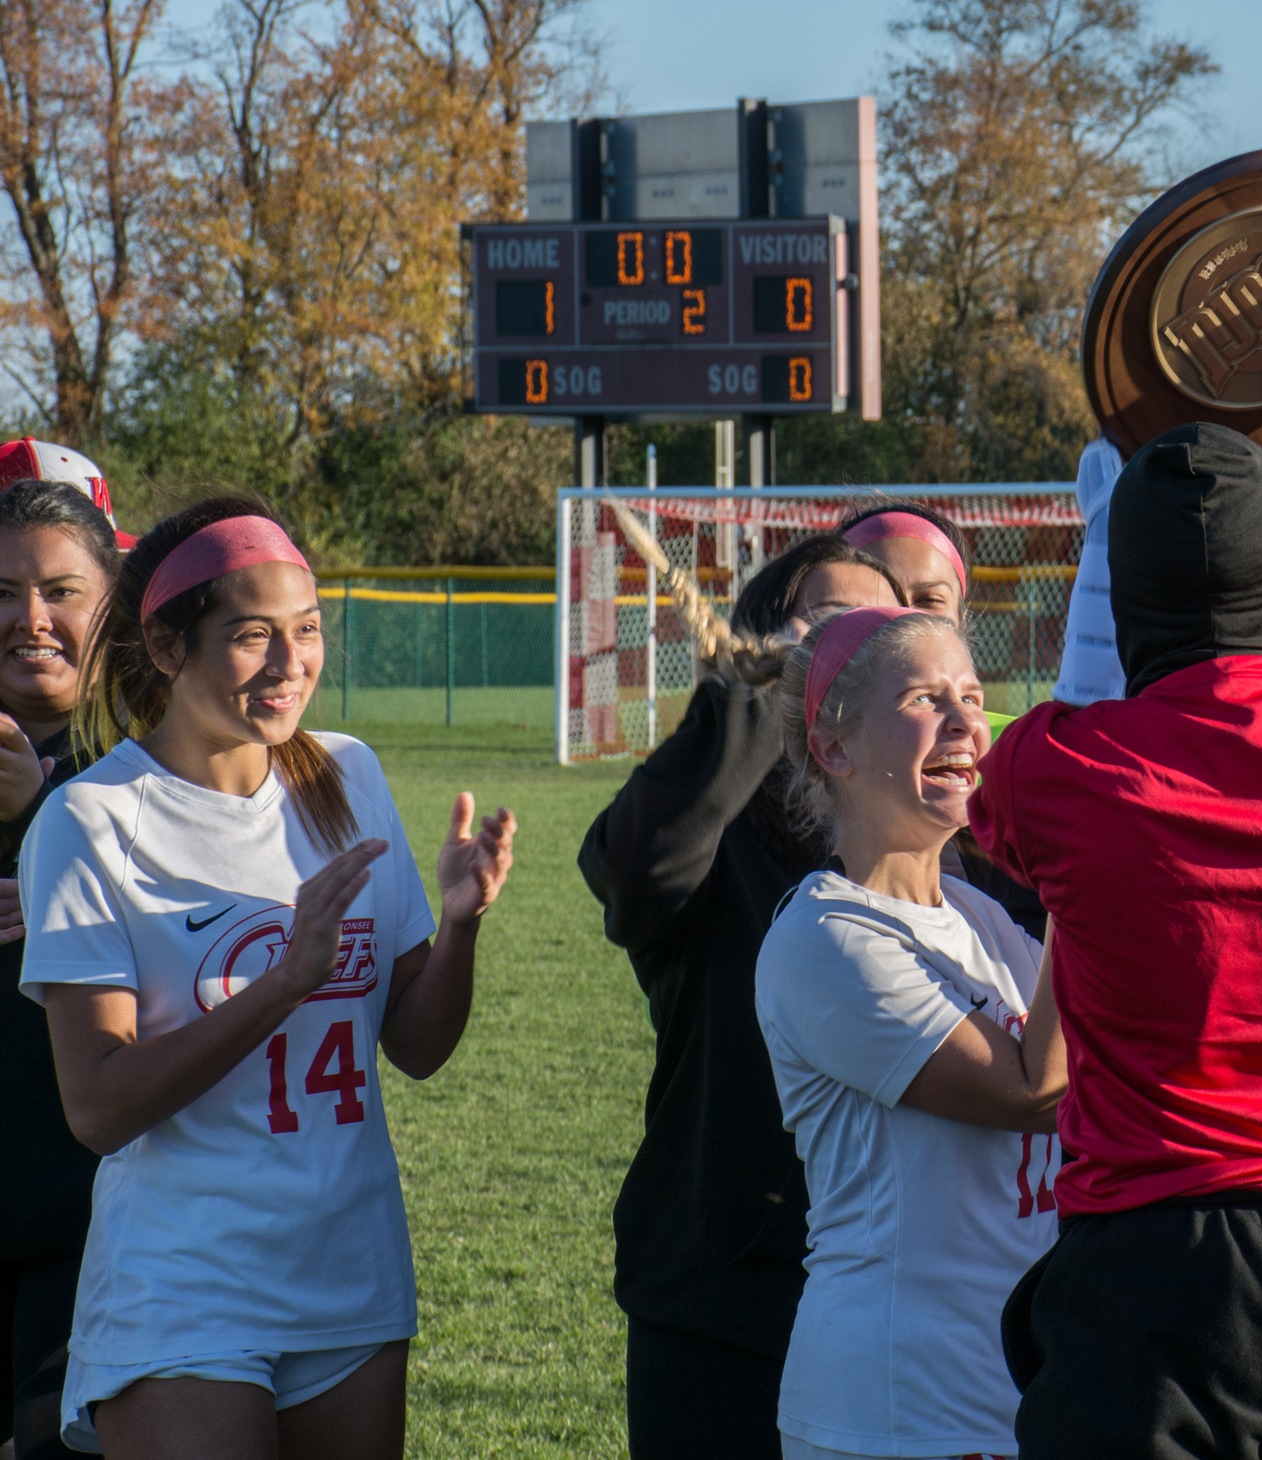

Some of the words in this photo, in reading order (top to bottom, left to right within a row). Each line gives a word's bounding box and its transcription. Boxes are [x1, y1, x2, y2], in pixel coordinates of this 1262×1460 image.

[487, 238, 561, 269] HOME
[740, 234, 828, 266] VISITOR
[545, 281, 554, 334] 1
[604, 300, 670, 326] PERIOD
[683, 290, 706, 334] 2
[786, 278, 812, 332] 0
[525, 360, 549, 403] 0
[553, 365, 601, 396] SOG
[708, 364, 757, 395] SOG
[789, 357, 812, 401] 0
[265, 1020, 366, 1134] 14
